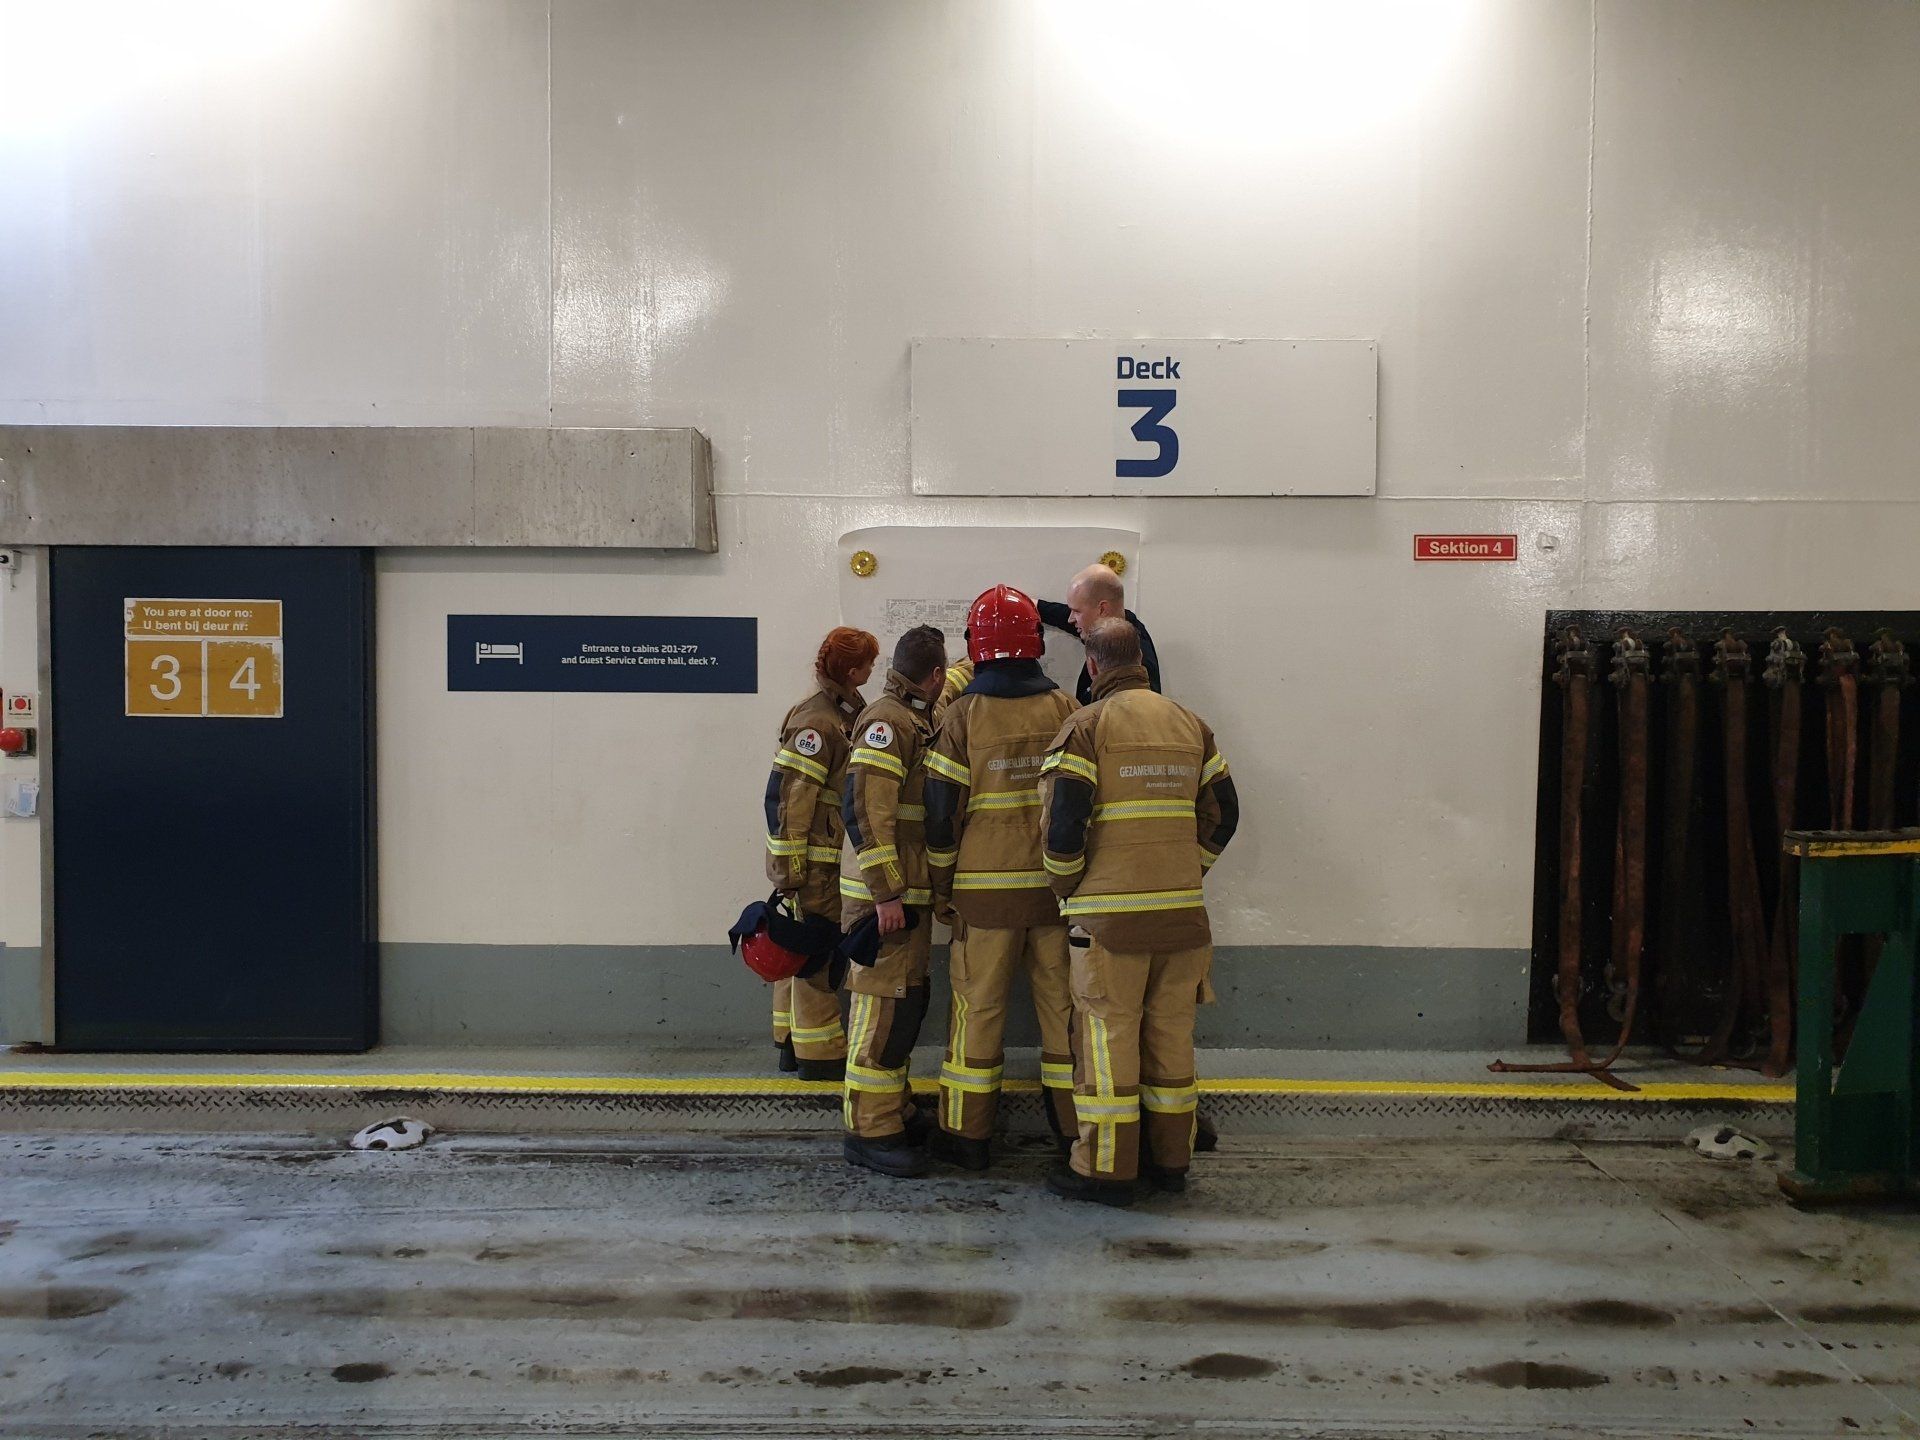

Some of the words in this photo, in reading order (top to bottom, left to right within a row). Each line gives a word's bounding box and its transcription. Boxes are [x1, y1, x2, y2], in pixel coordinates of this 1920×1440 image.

[1117, 356, 1181, 379] Deck
[1115, 389, 1179, 478] 3
[1429, 541, 1488, 554] Sektion
[1493, 541, 1502, 554] 4
[142, 606, 165, 617] You
[167, 609, 187, 617] are
[189, 607, 201, 617] at
[204, 607, 232, 618] door
[234, 609, 253, 618] no:
[143, 620, 152, 630] U
[155, 620, 182, 630] bent
[184, 621, 200, 632] bij
[203, 621, 229, 631] deur
[232, 623, 249, 631] nr:
[582, 644, 620, 653] Entrance
[621, 644, 631, 653] to
[632, 644, 660, 653] cabins
[661, 644, 698, 654] 201-277
[561, 655, 577, 664] and
[579, 655, 604, 665] Guest
[605, 656, 636, 665] Service
[638, 656, 666, 665] Centre
[667, 656, 687, 666] hall,
[688, 657, 708, 665] deck
[710, 657, 719, 665] 7.
[150, 654, 182, 701] 3
[229, 656, 261, 700] 4
[869, 732, 888, 743] GBA
[799, 738, 817, 751] GBA
